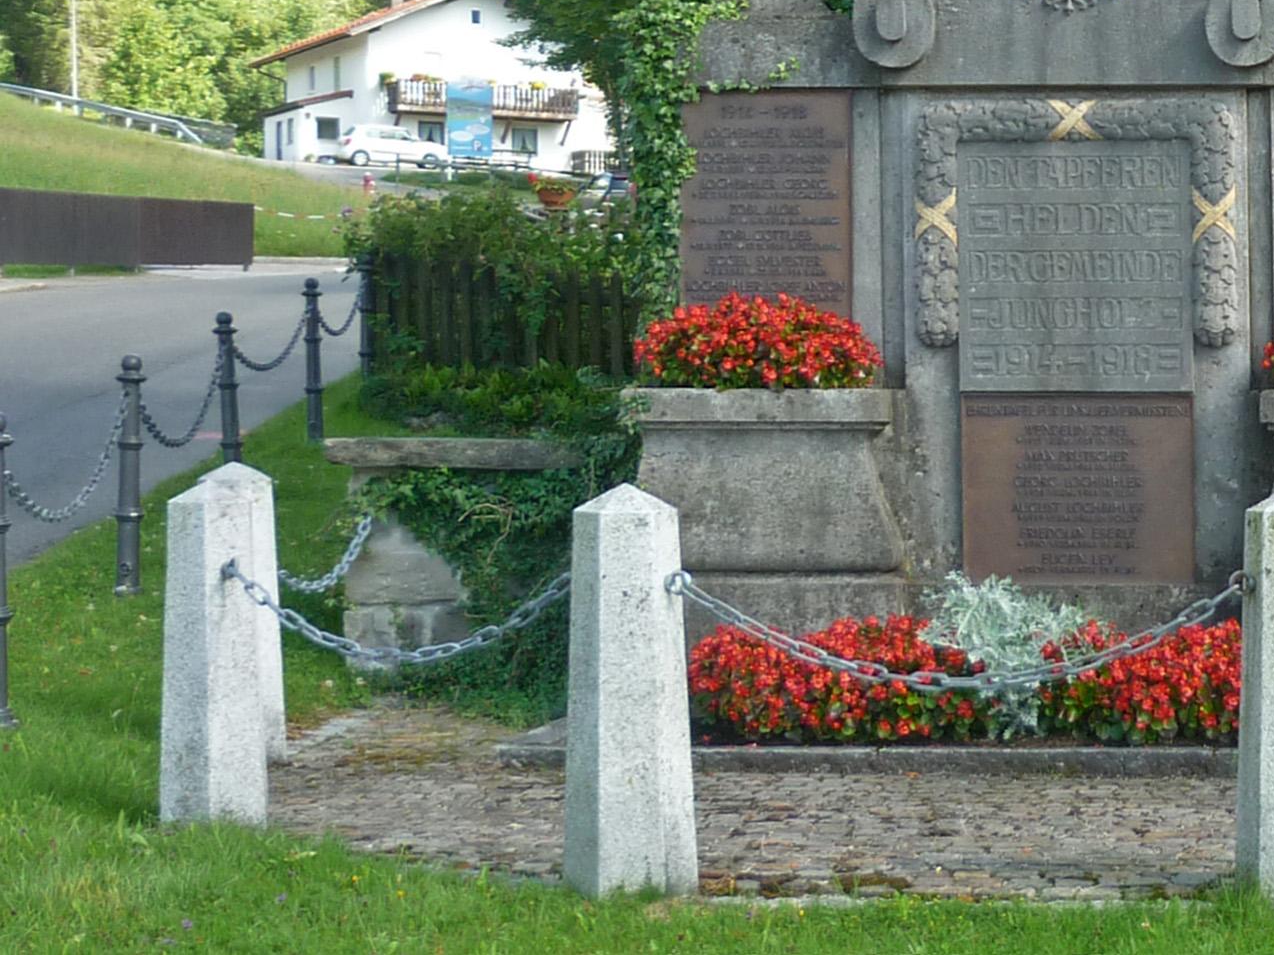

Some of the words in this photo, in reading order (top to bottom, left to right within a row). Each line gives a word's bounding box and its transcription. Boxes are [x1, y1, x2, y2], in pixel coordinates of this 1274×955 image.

[967, 156, 1022, 189] DEN
[1031, 156, 1180, 189] TAPFEREN
[1005, 204, 1141, 234] HELDEN
[968, 251, 1025, 283] DER
[1028, 251, 1183, 283] GEMEINDE
